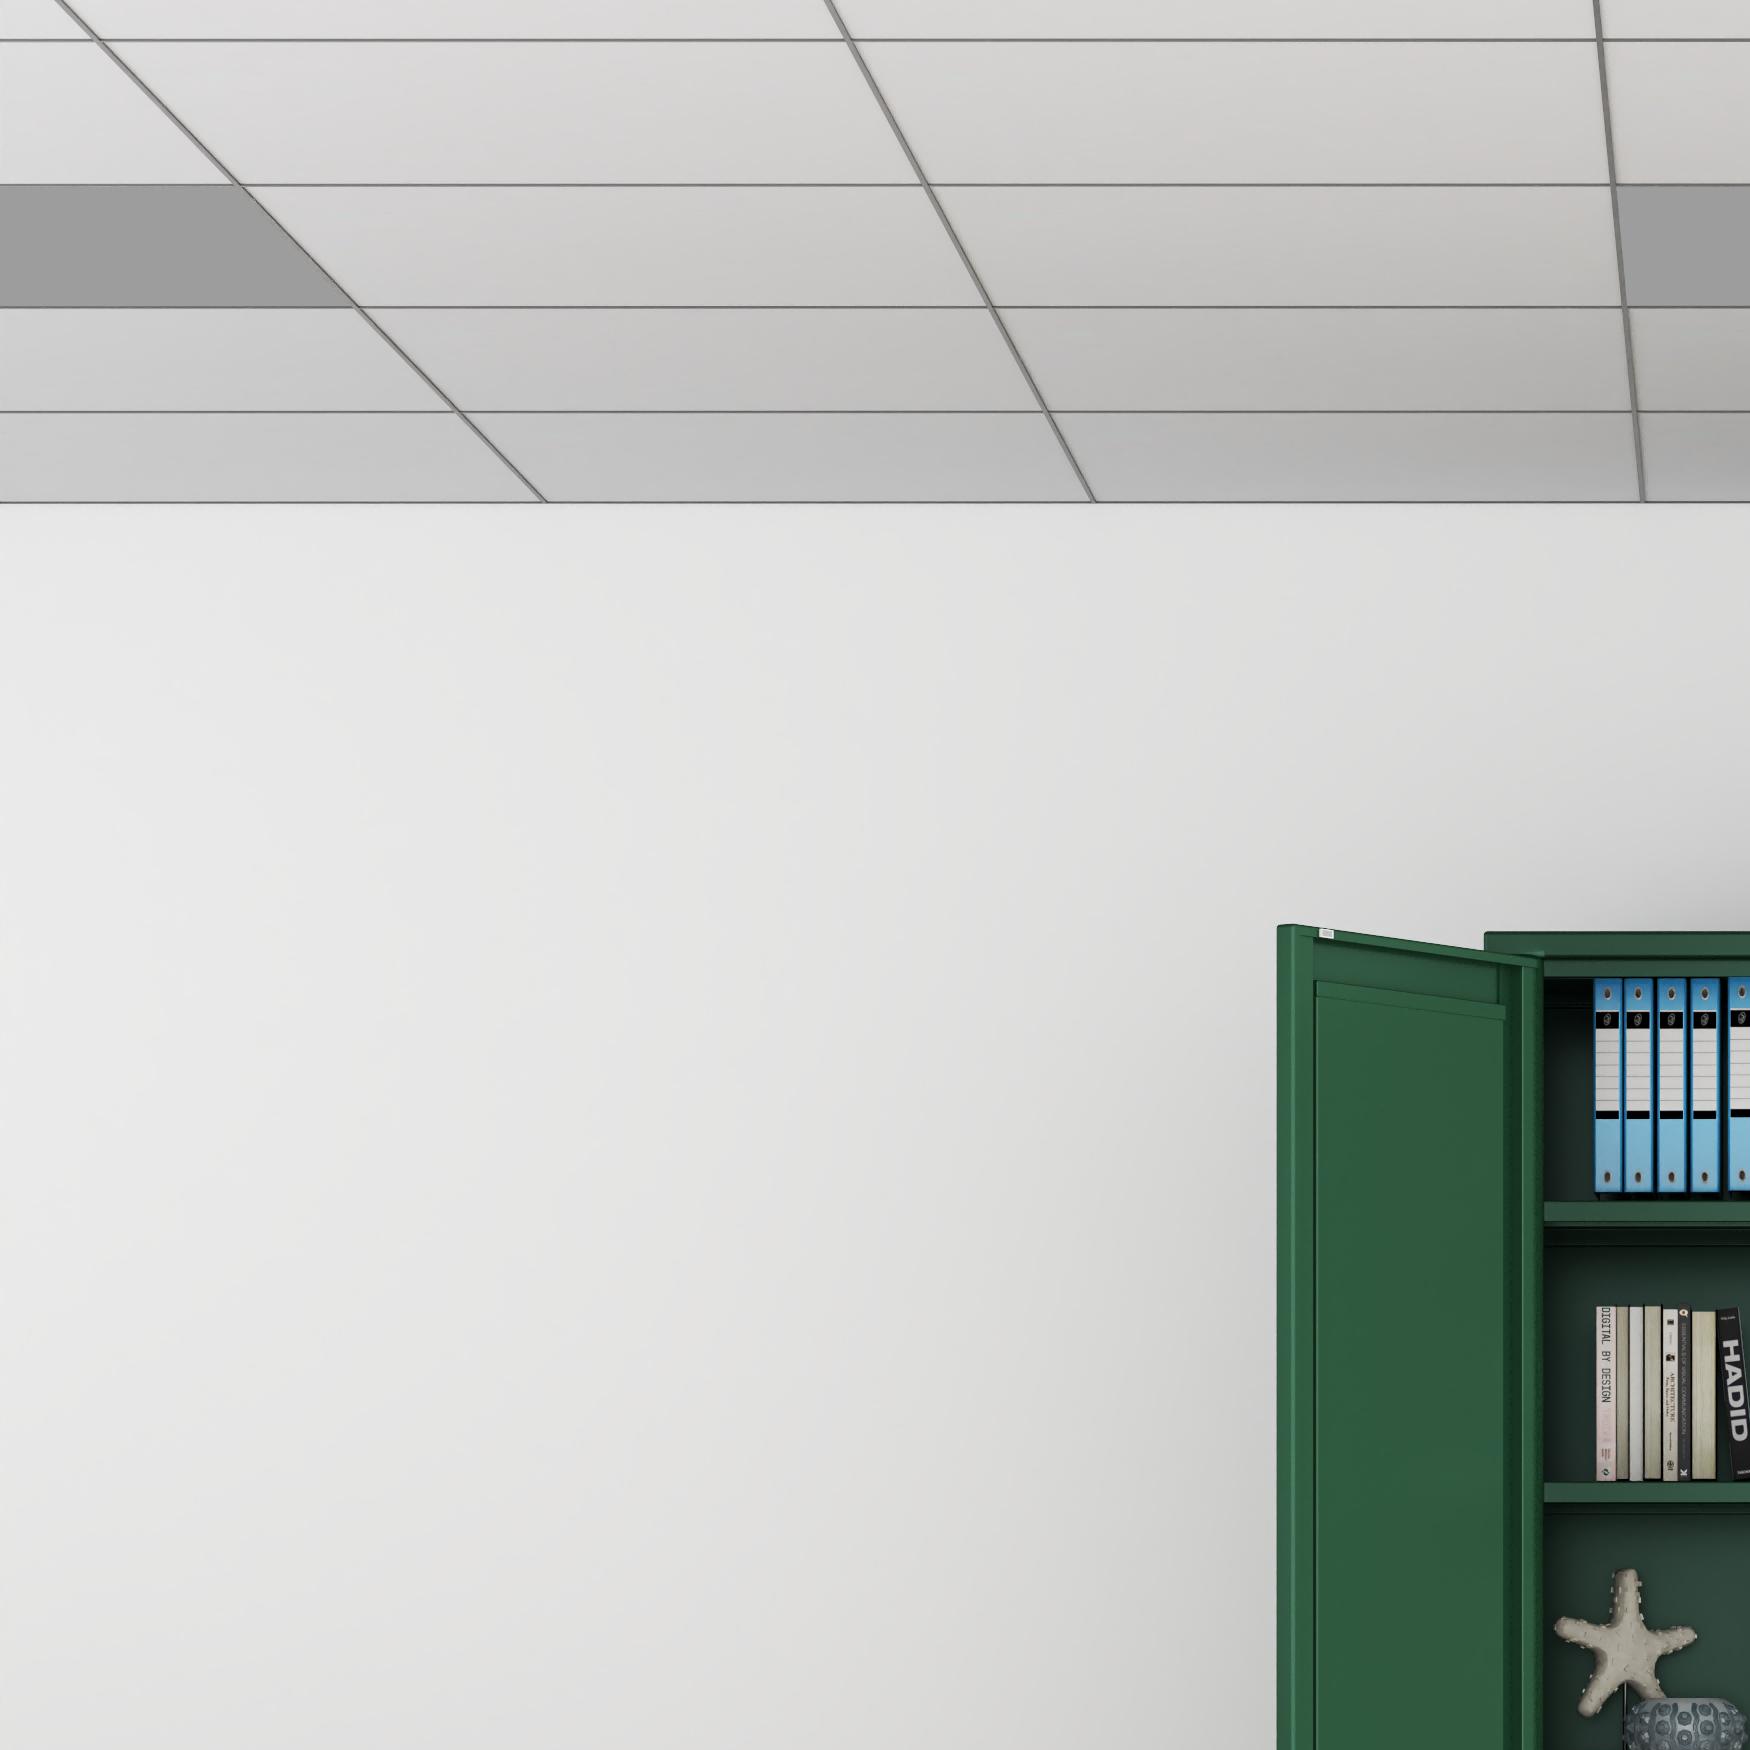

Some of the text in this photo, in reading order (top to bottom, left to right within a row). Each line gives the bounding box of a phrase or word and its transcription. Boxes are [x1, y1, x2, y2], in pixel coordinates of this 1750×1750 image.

[1601, 1307, 1611, 1403] DIGITAL BY DESIGN
[1722, 1339, 1748, 1442] HADID
